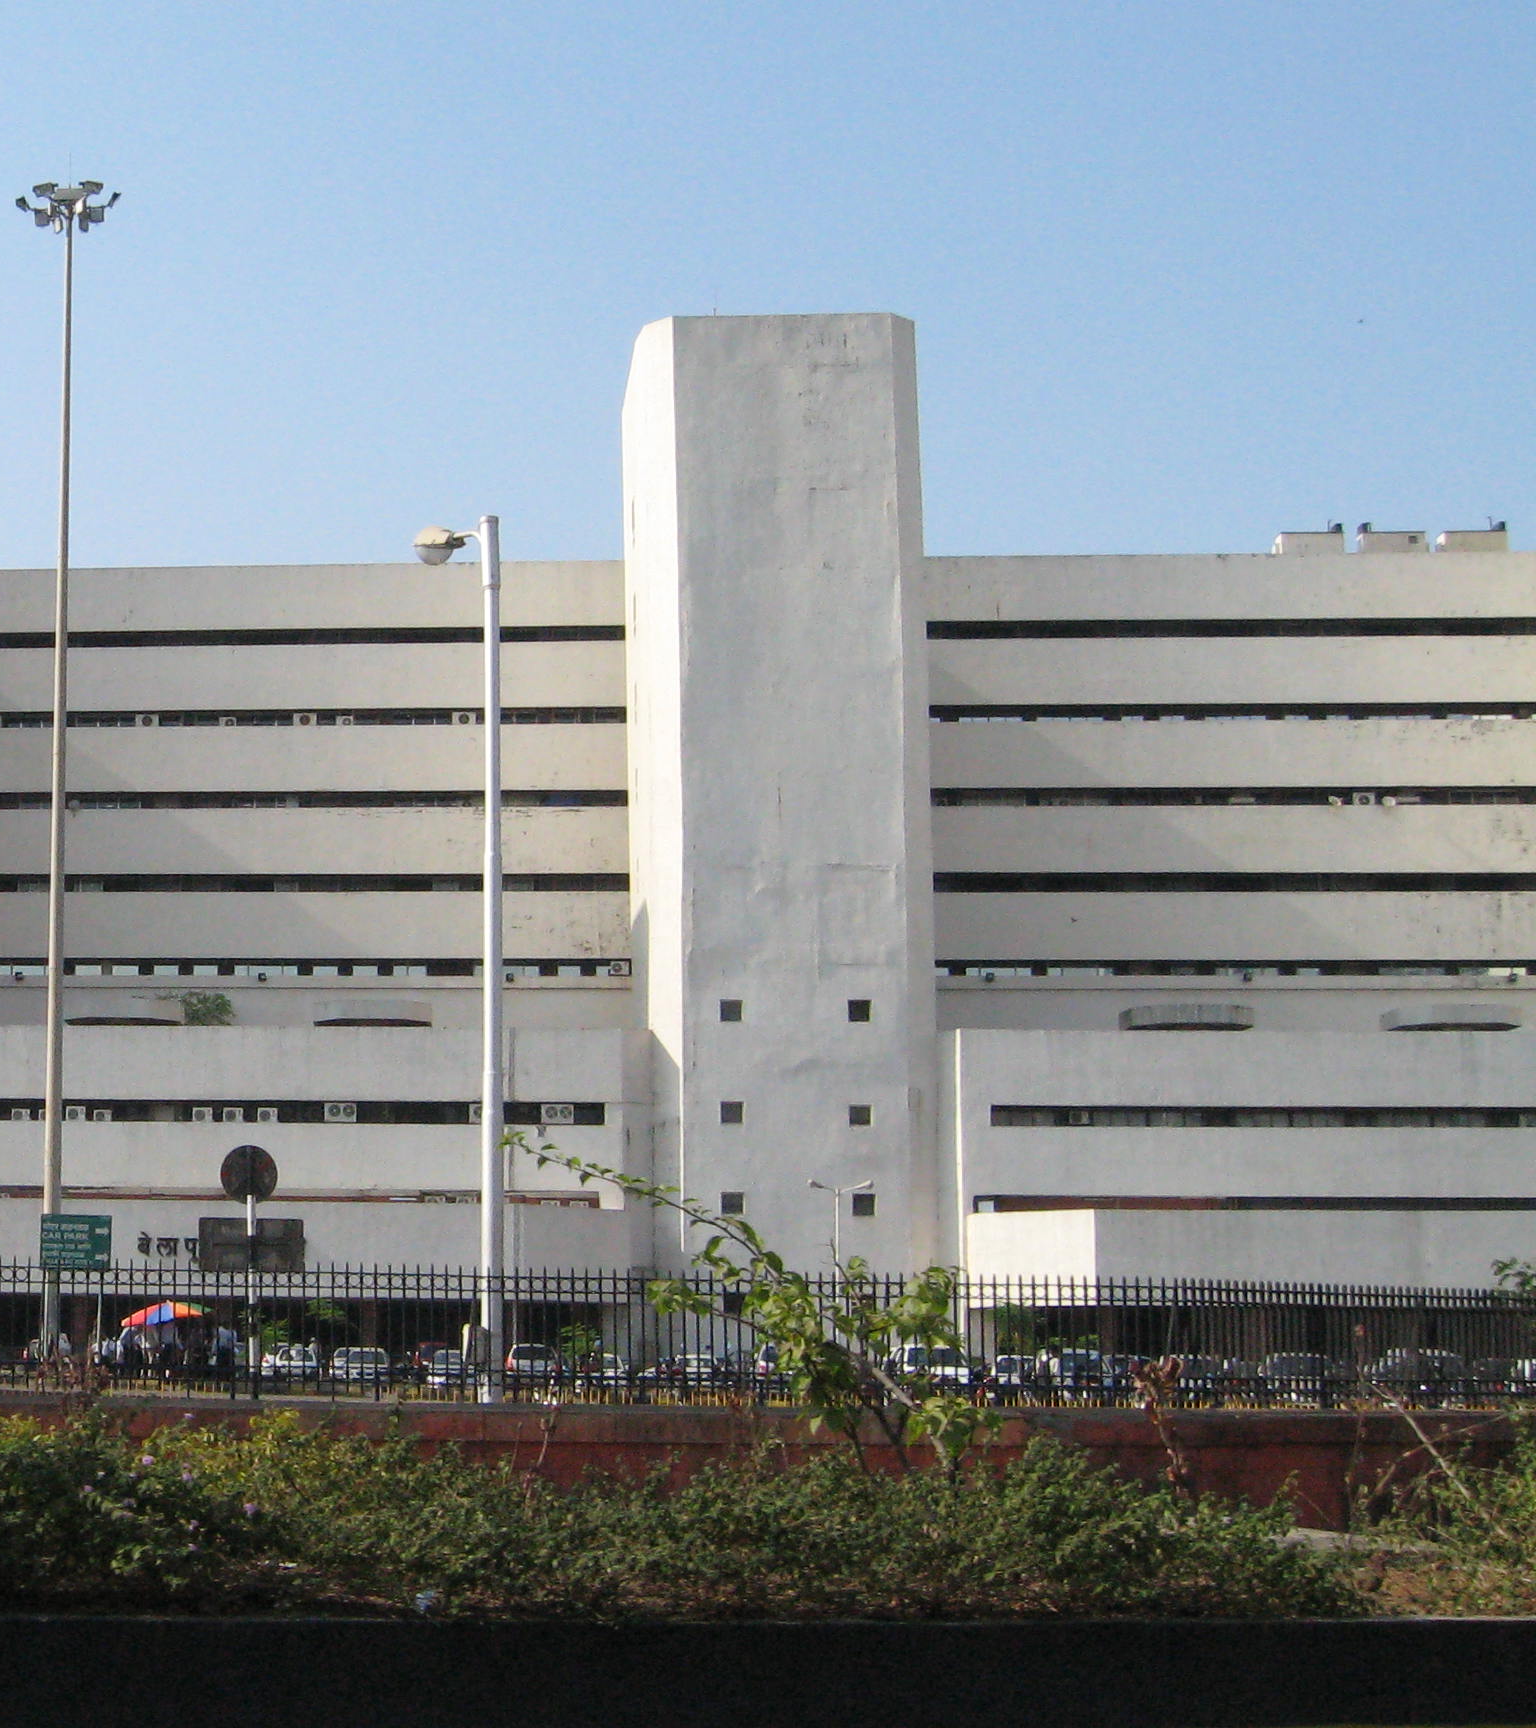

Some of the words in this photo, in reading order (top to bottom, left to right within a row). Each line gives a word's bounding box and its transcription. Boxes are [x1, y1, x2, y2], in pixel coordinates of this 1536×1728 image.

[42, 1231, 61, 1240] CAR
[63, 1231, 89, 1241] PARK
[137, 1230, 199, 1264] बेलापू
